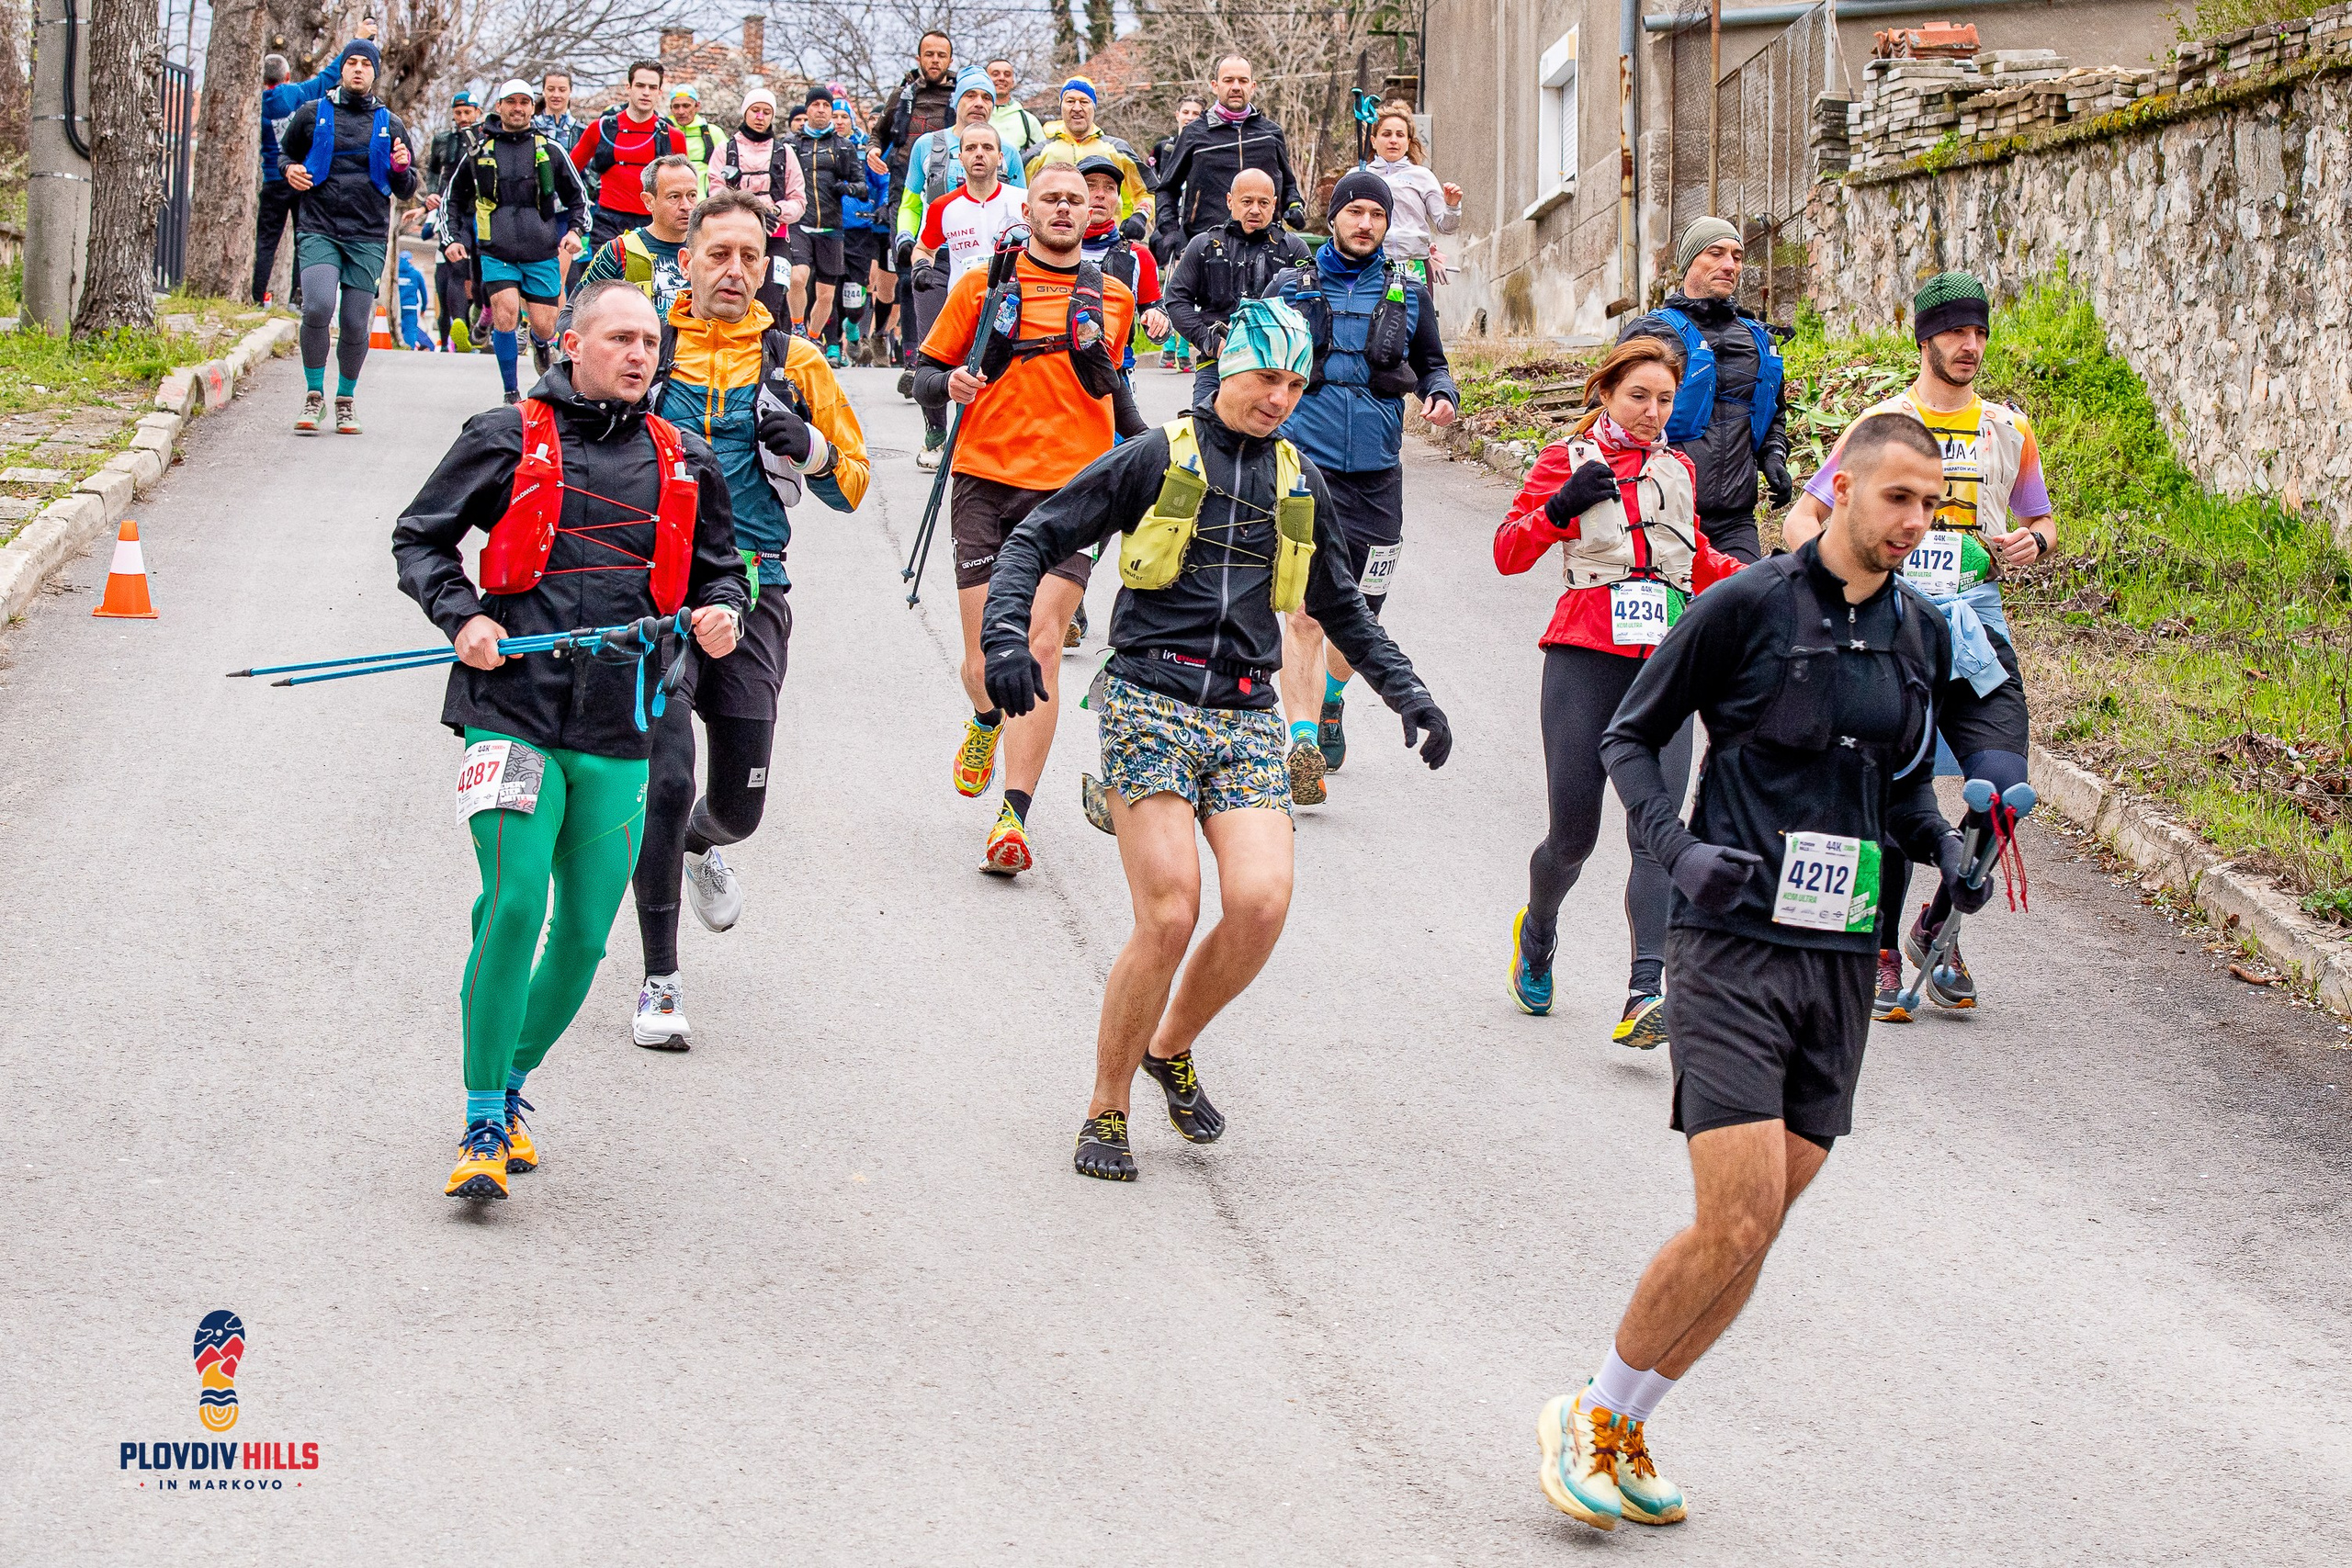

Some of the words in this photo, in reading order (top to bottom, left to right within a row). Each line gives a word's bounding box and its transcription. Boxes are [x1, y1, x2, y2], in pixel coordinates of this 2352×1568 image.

[511, 482, 540, 505] SALOMON
[1369, 558, 1396, 577] 4211
[1908, 548, 1954, 570] 4172
[1614, 600, 1665, 623] 4234
[458, 761, 500, 794] 4287
[1826, 840, 1842, 852] 44K
[1787, 860, 1849, 895] 4212
